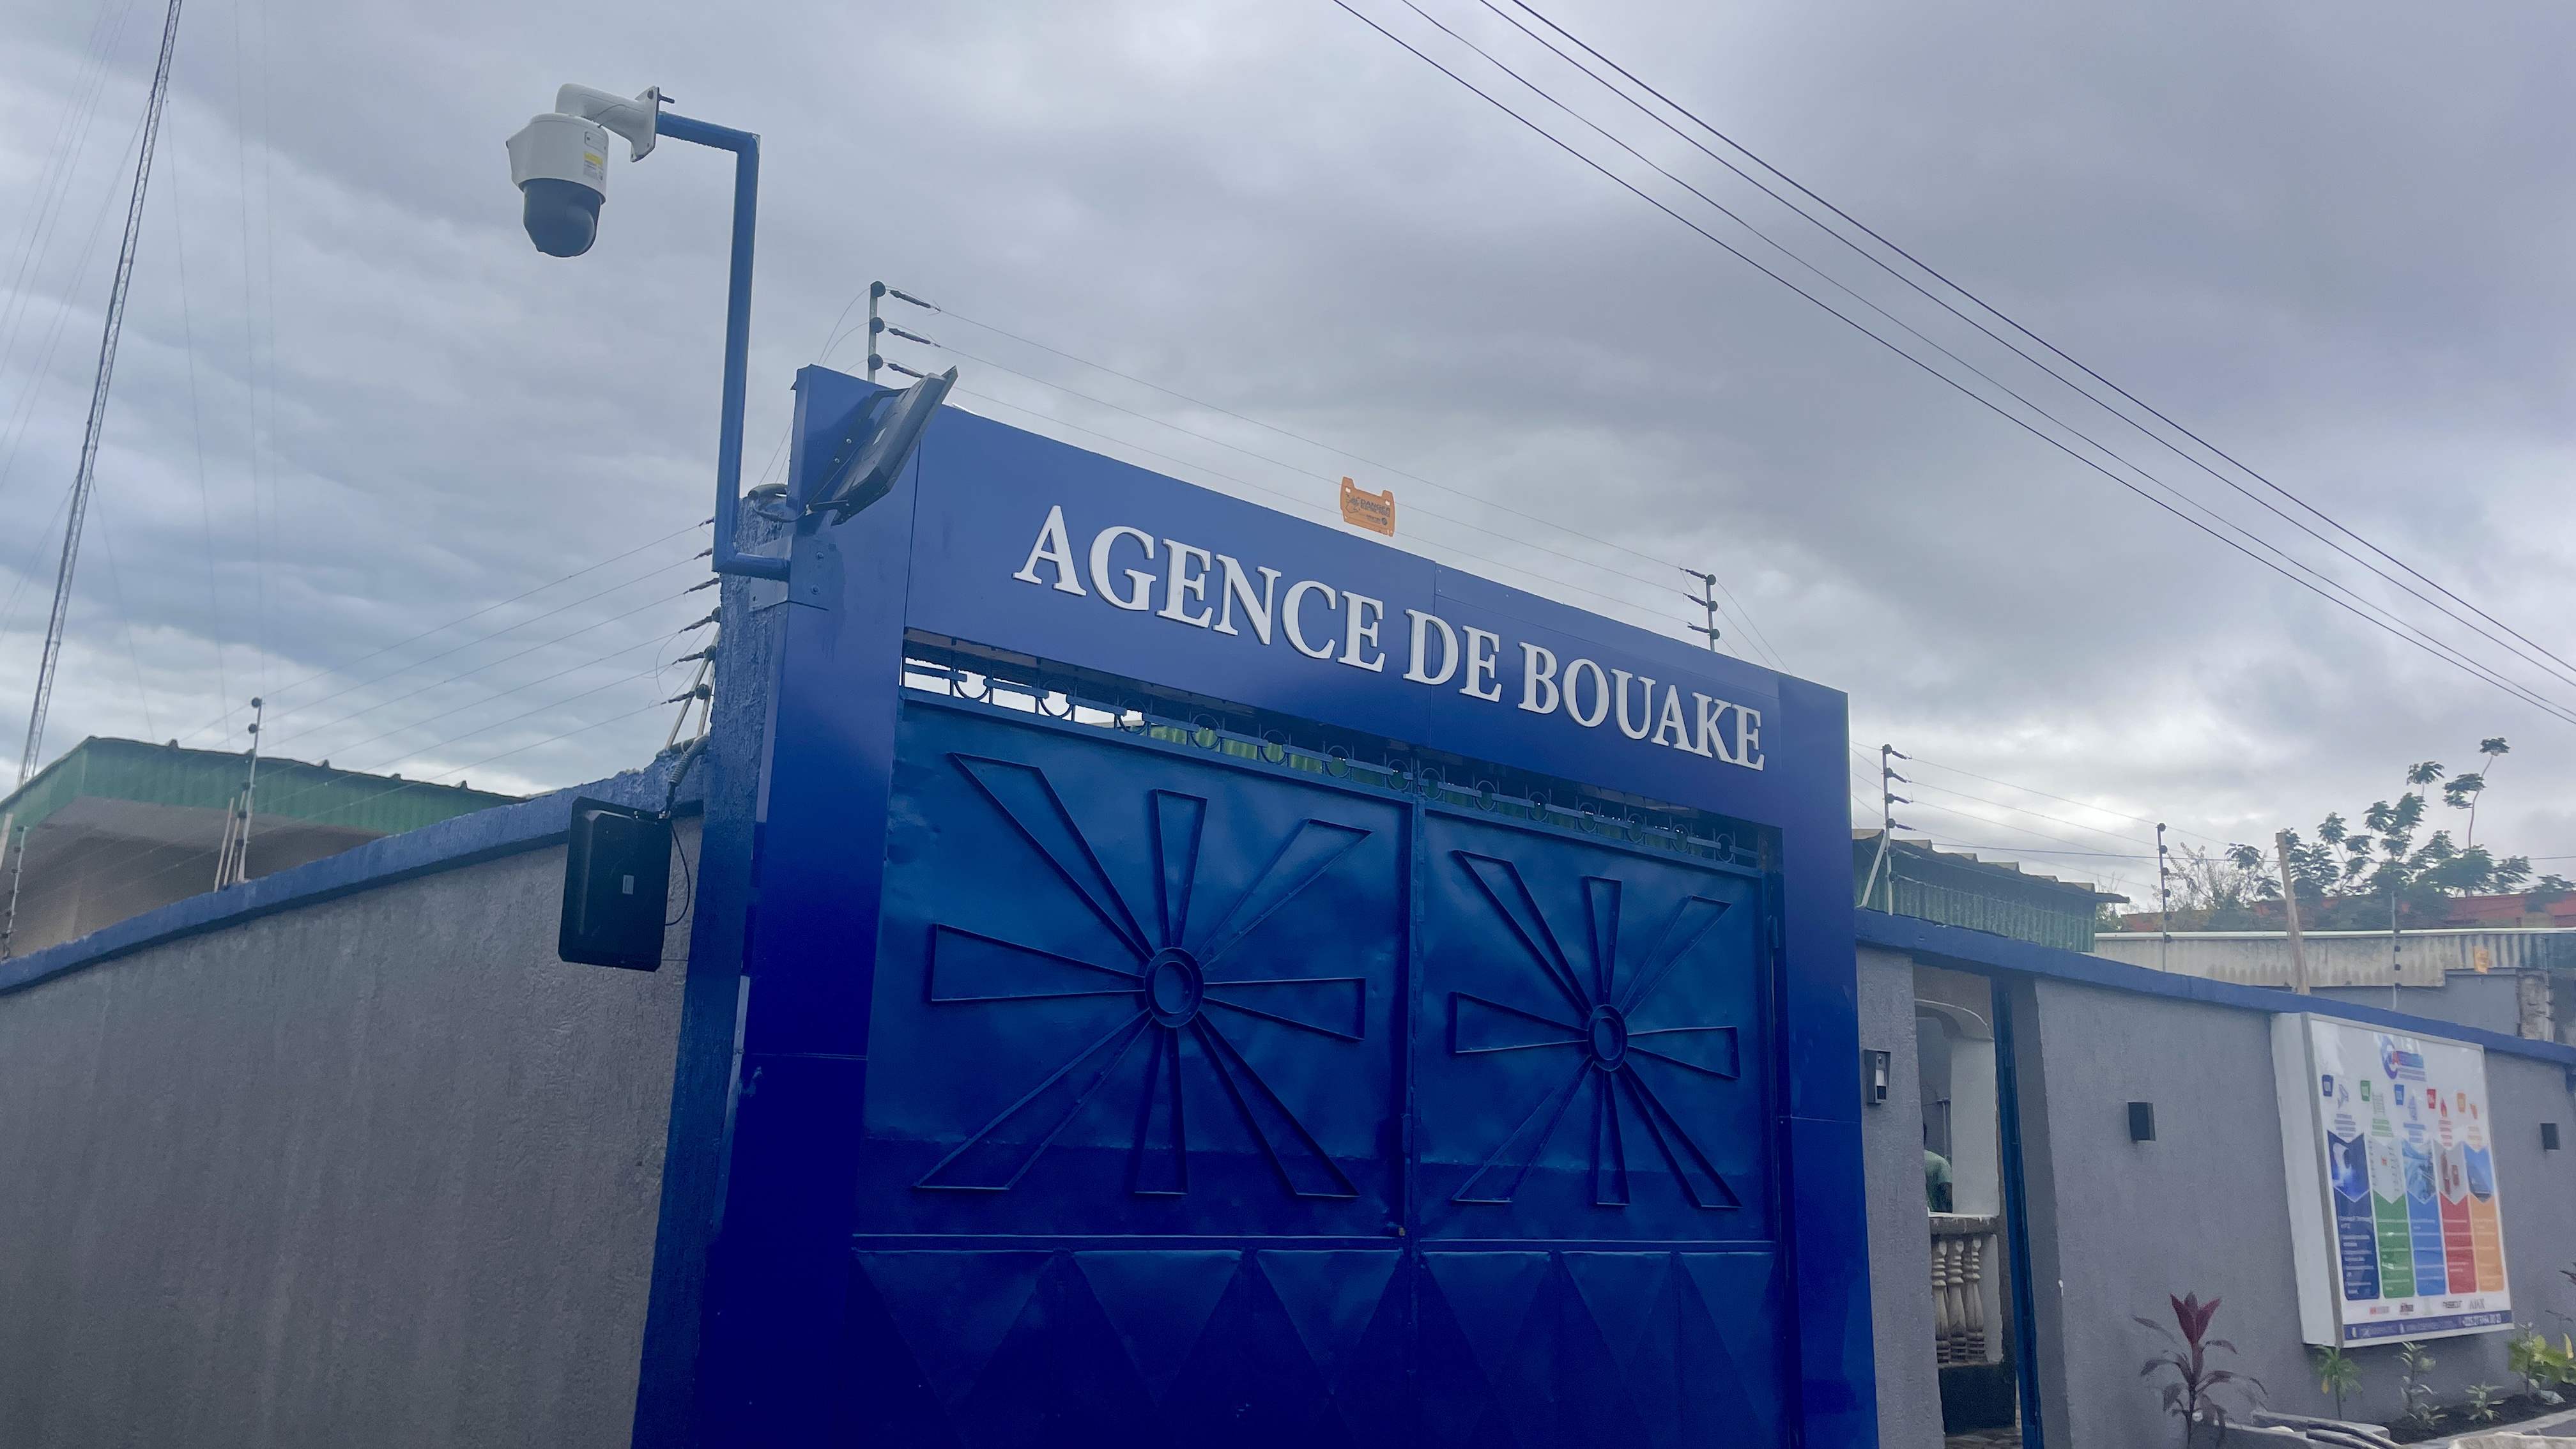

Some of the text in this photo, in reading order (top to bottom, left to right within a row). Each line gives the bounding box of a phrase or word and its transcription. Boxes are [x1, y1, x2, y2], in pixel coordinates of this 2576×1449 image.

[1361, 499, 1391, 512] DANGER
[1012, 505, 1765, 770] AGENCE DE BOUAKE
